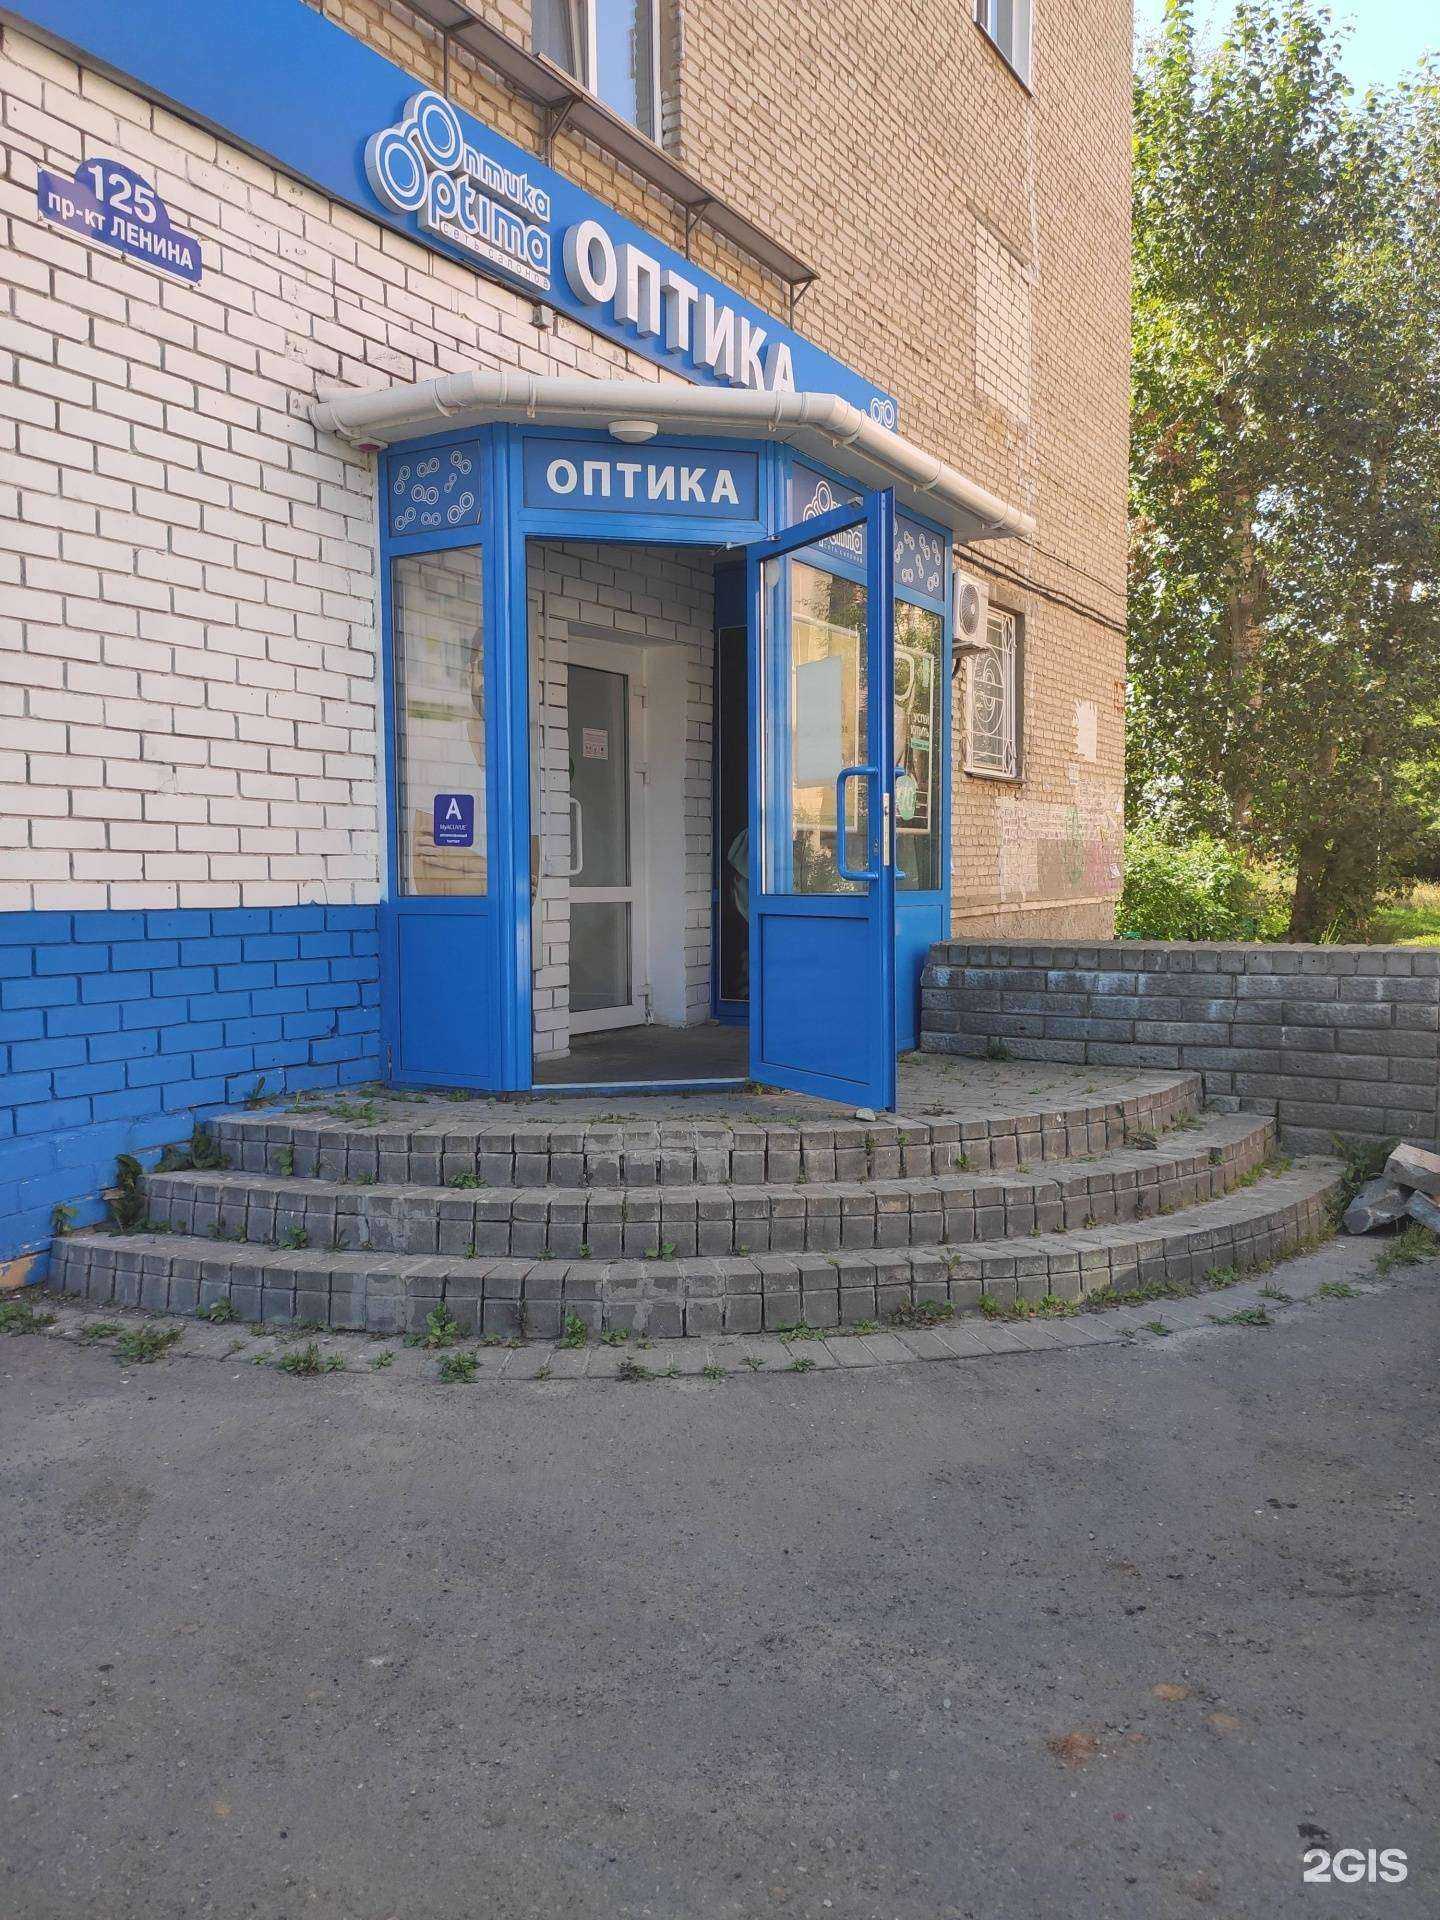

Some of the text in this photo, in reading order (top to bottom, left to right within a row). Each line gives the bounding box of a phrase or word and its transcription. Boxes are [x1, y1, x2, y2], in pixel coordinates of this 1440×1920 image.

[87, 164, 157, 223] 125
[48, 191, 194, 271] пр-кт ЛЕНИНА
[563, 219, 796, 392] ОПТИКА
[546, 458, 740, 505] ОПТИКА
